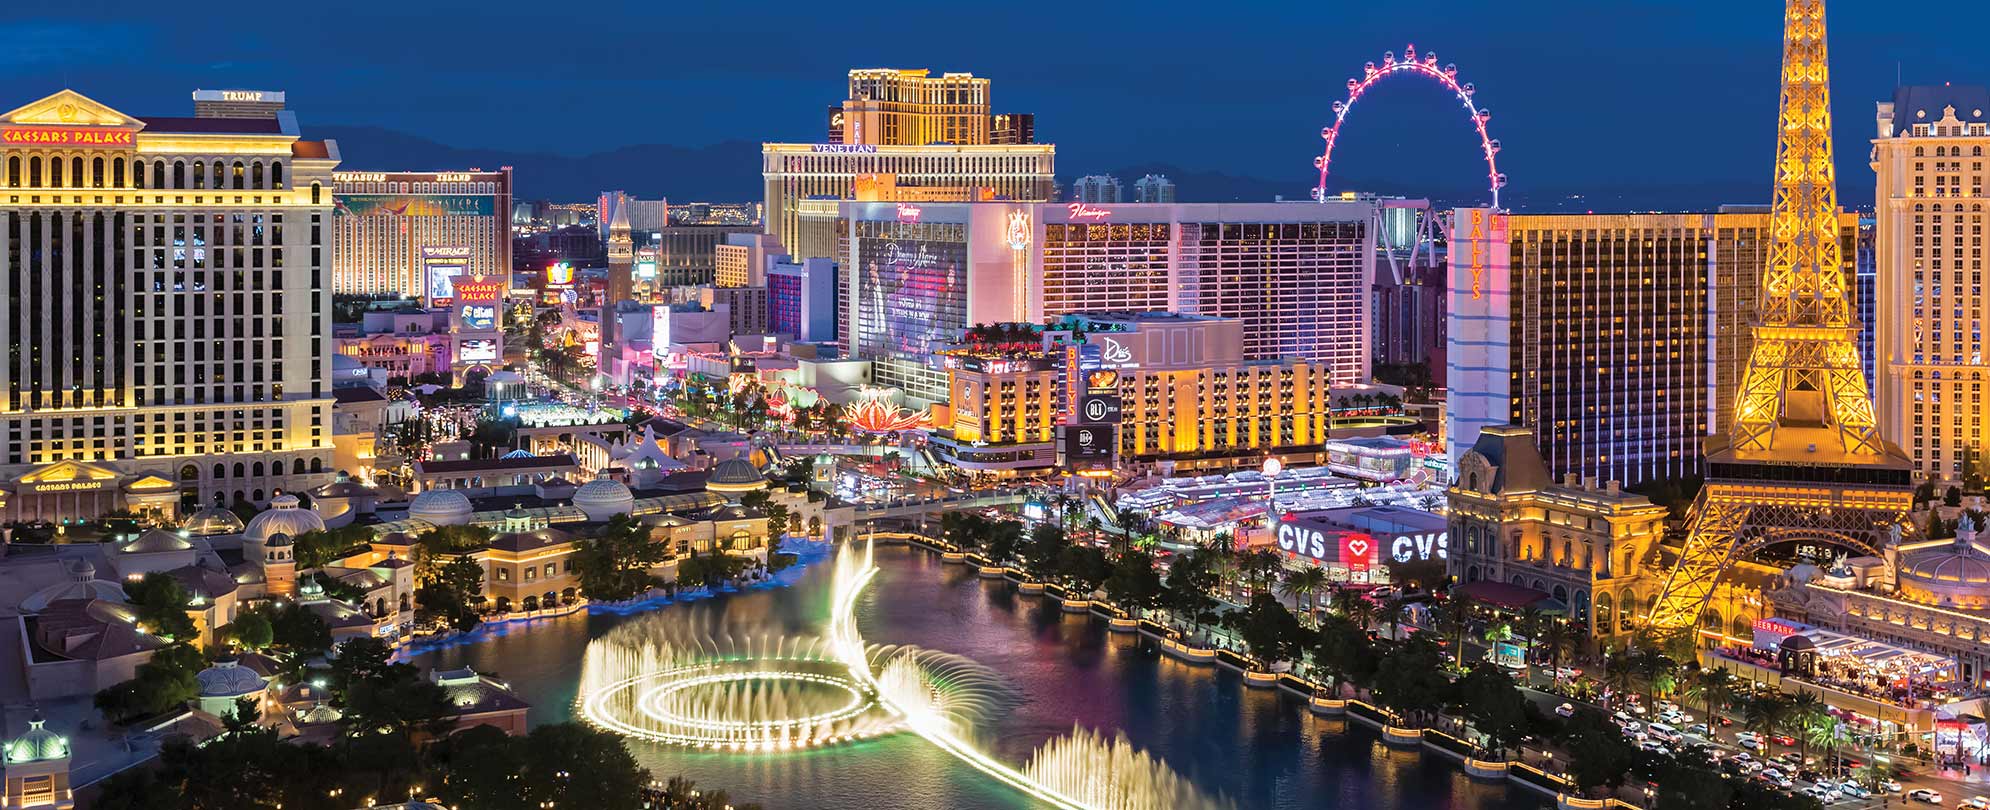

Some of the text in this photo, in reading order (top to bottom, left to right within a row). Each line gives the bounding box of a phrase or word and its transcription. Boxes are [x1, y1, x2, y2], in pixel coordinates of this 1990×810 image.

[222, 91, 262, 101] TRUMP
[3, 131, 131, 143] CAESARS PALACE
[814, 144, 873, 153] VENETIAN
[332, 174, 471, 182] TREASURE ISLAND
[1068, 203, 1111, 220] Flamingo
[1090, 403, 1103, 416] BLT
[1279, 524, 1325, 558] CVS
[1753, 620, 1793, 635] BEER PARK
